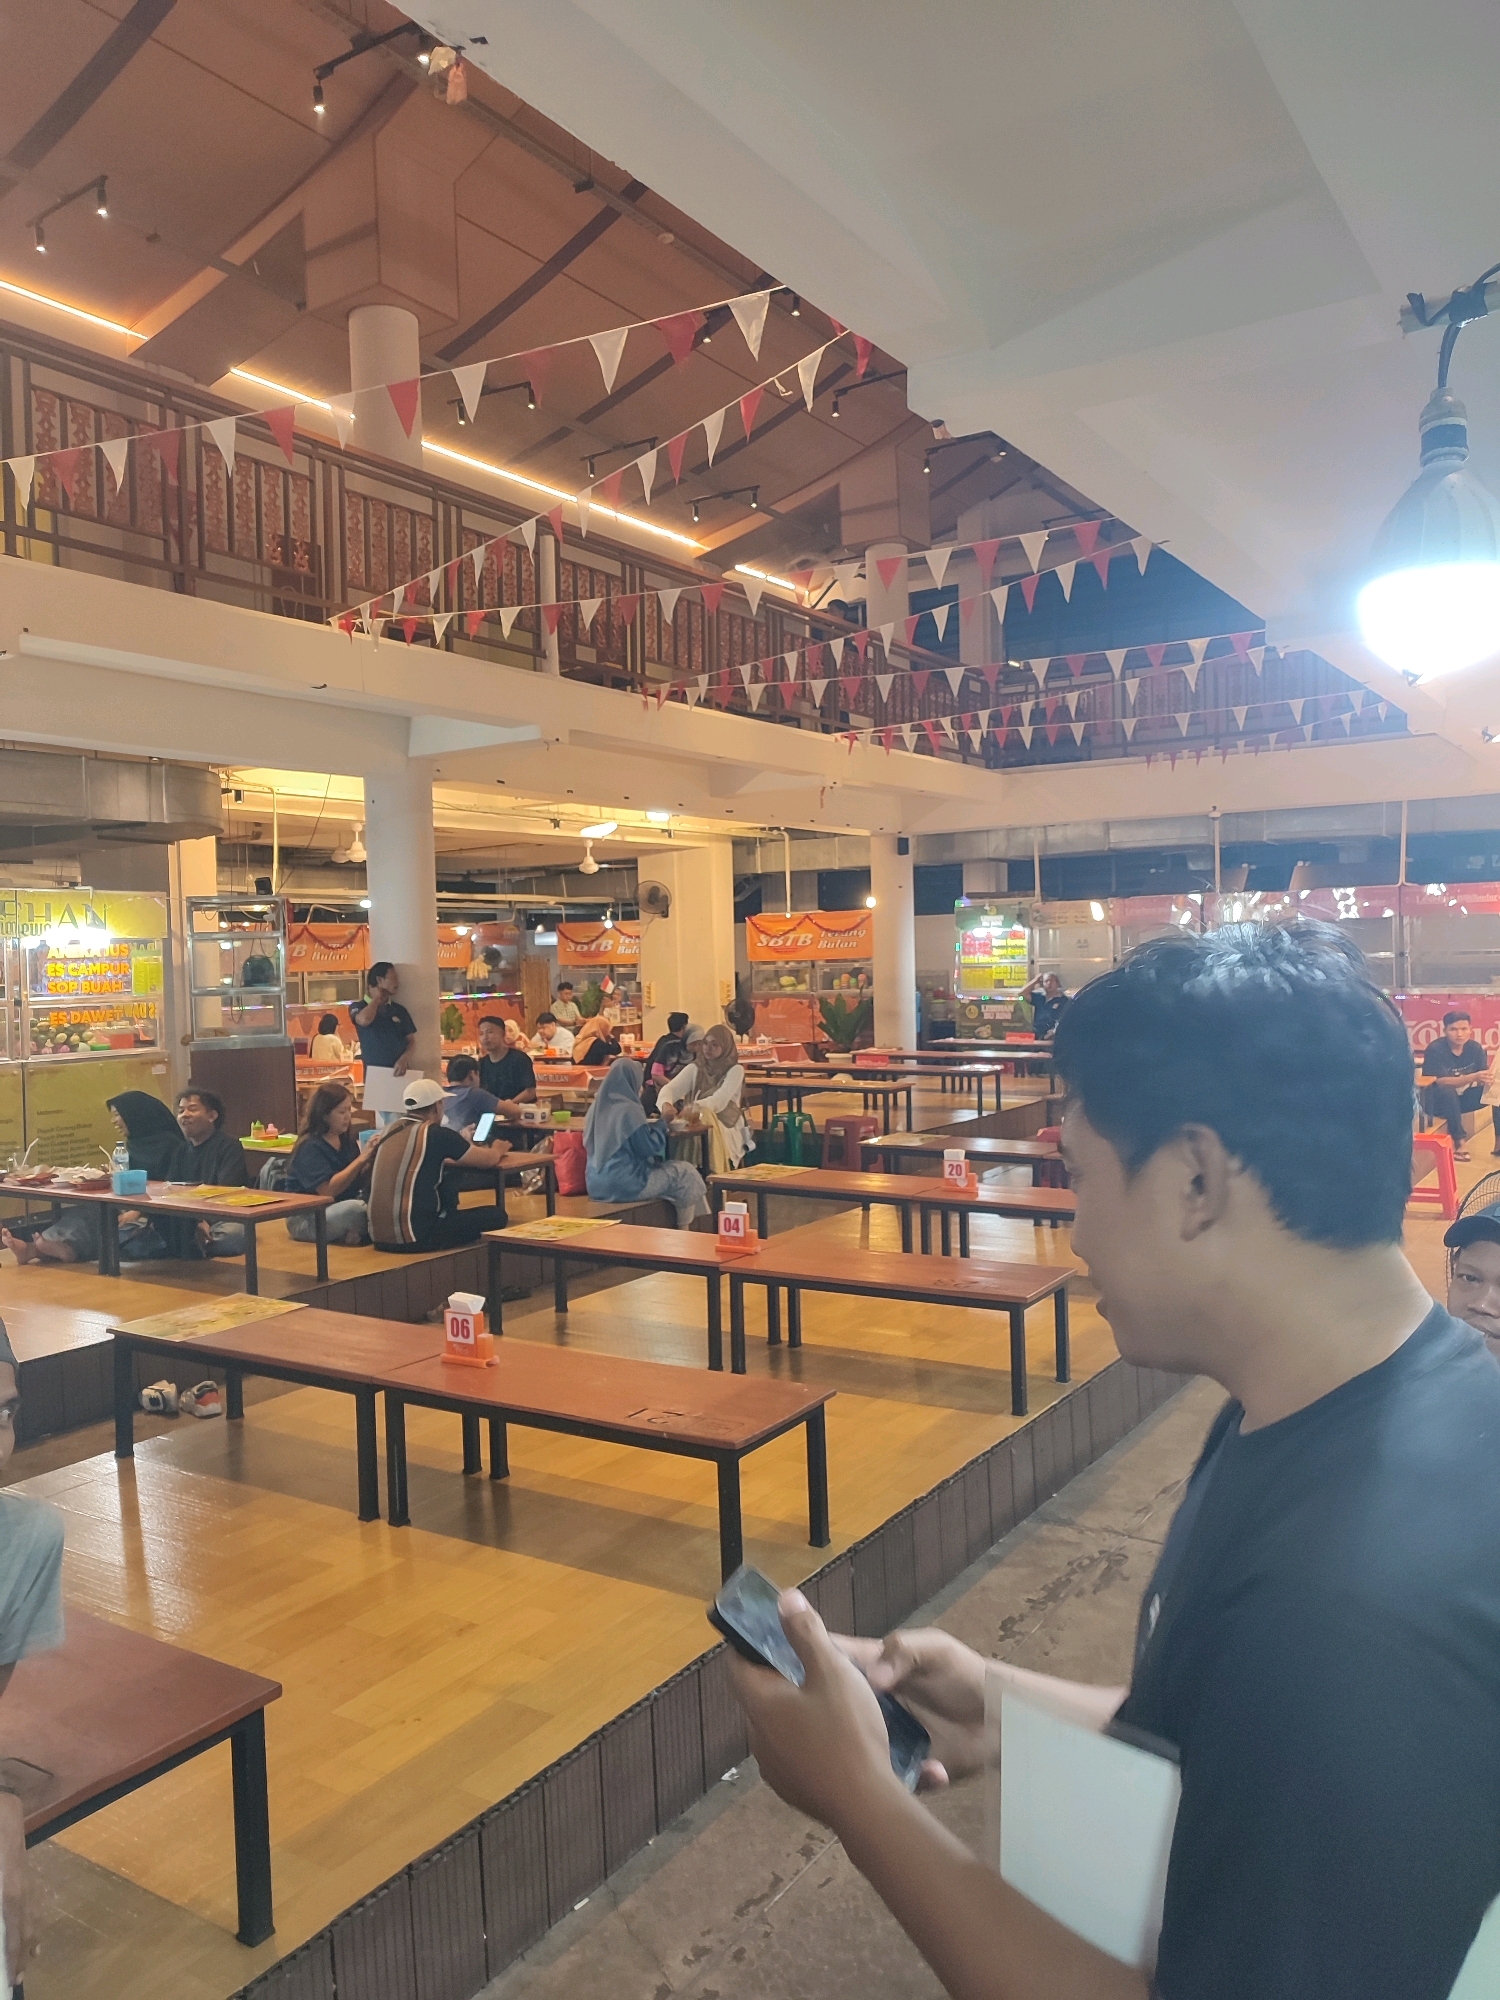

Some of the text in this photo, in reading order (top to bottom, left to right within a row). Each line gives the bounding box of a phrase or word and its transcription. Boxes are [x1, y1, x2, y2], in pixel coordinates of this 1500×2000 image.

[817, 940, 857, 949] Bulan
[46, 961, 130, 977] ES CAMPUR
[47, 979, 124, 994] SOP BUAH
[49, 1010, 67, 1025] ES
[70, 1009, 123, 1025] DAWET
[948, 1163, 963, 1177] 20
[723, 1217, 740, 1234] 04
[450, 1316, 471, 1340] 06
